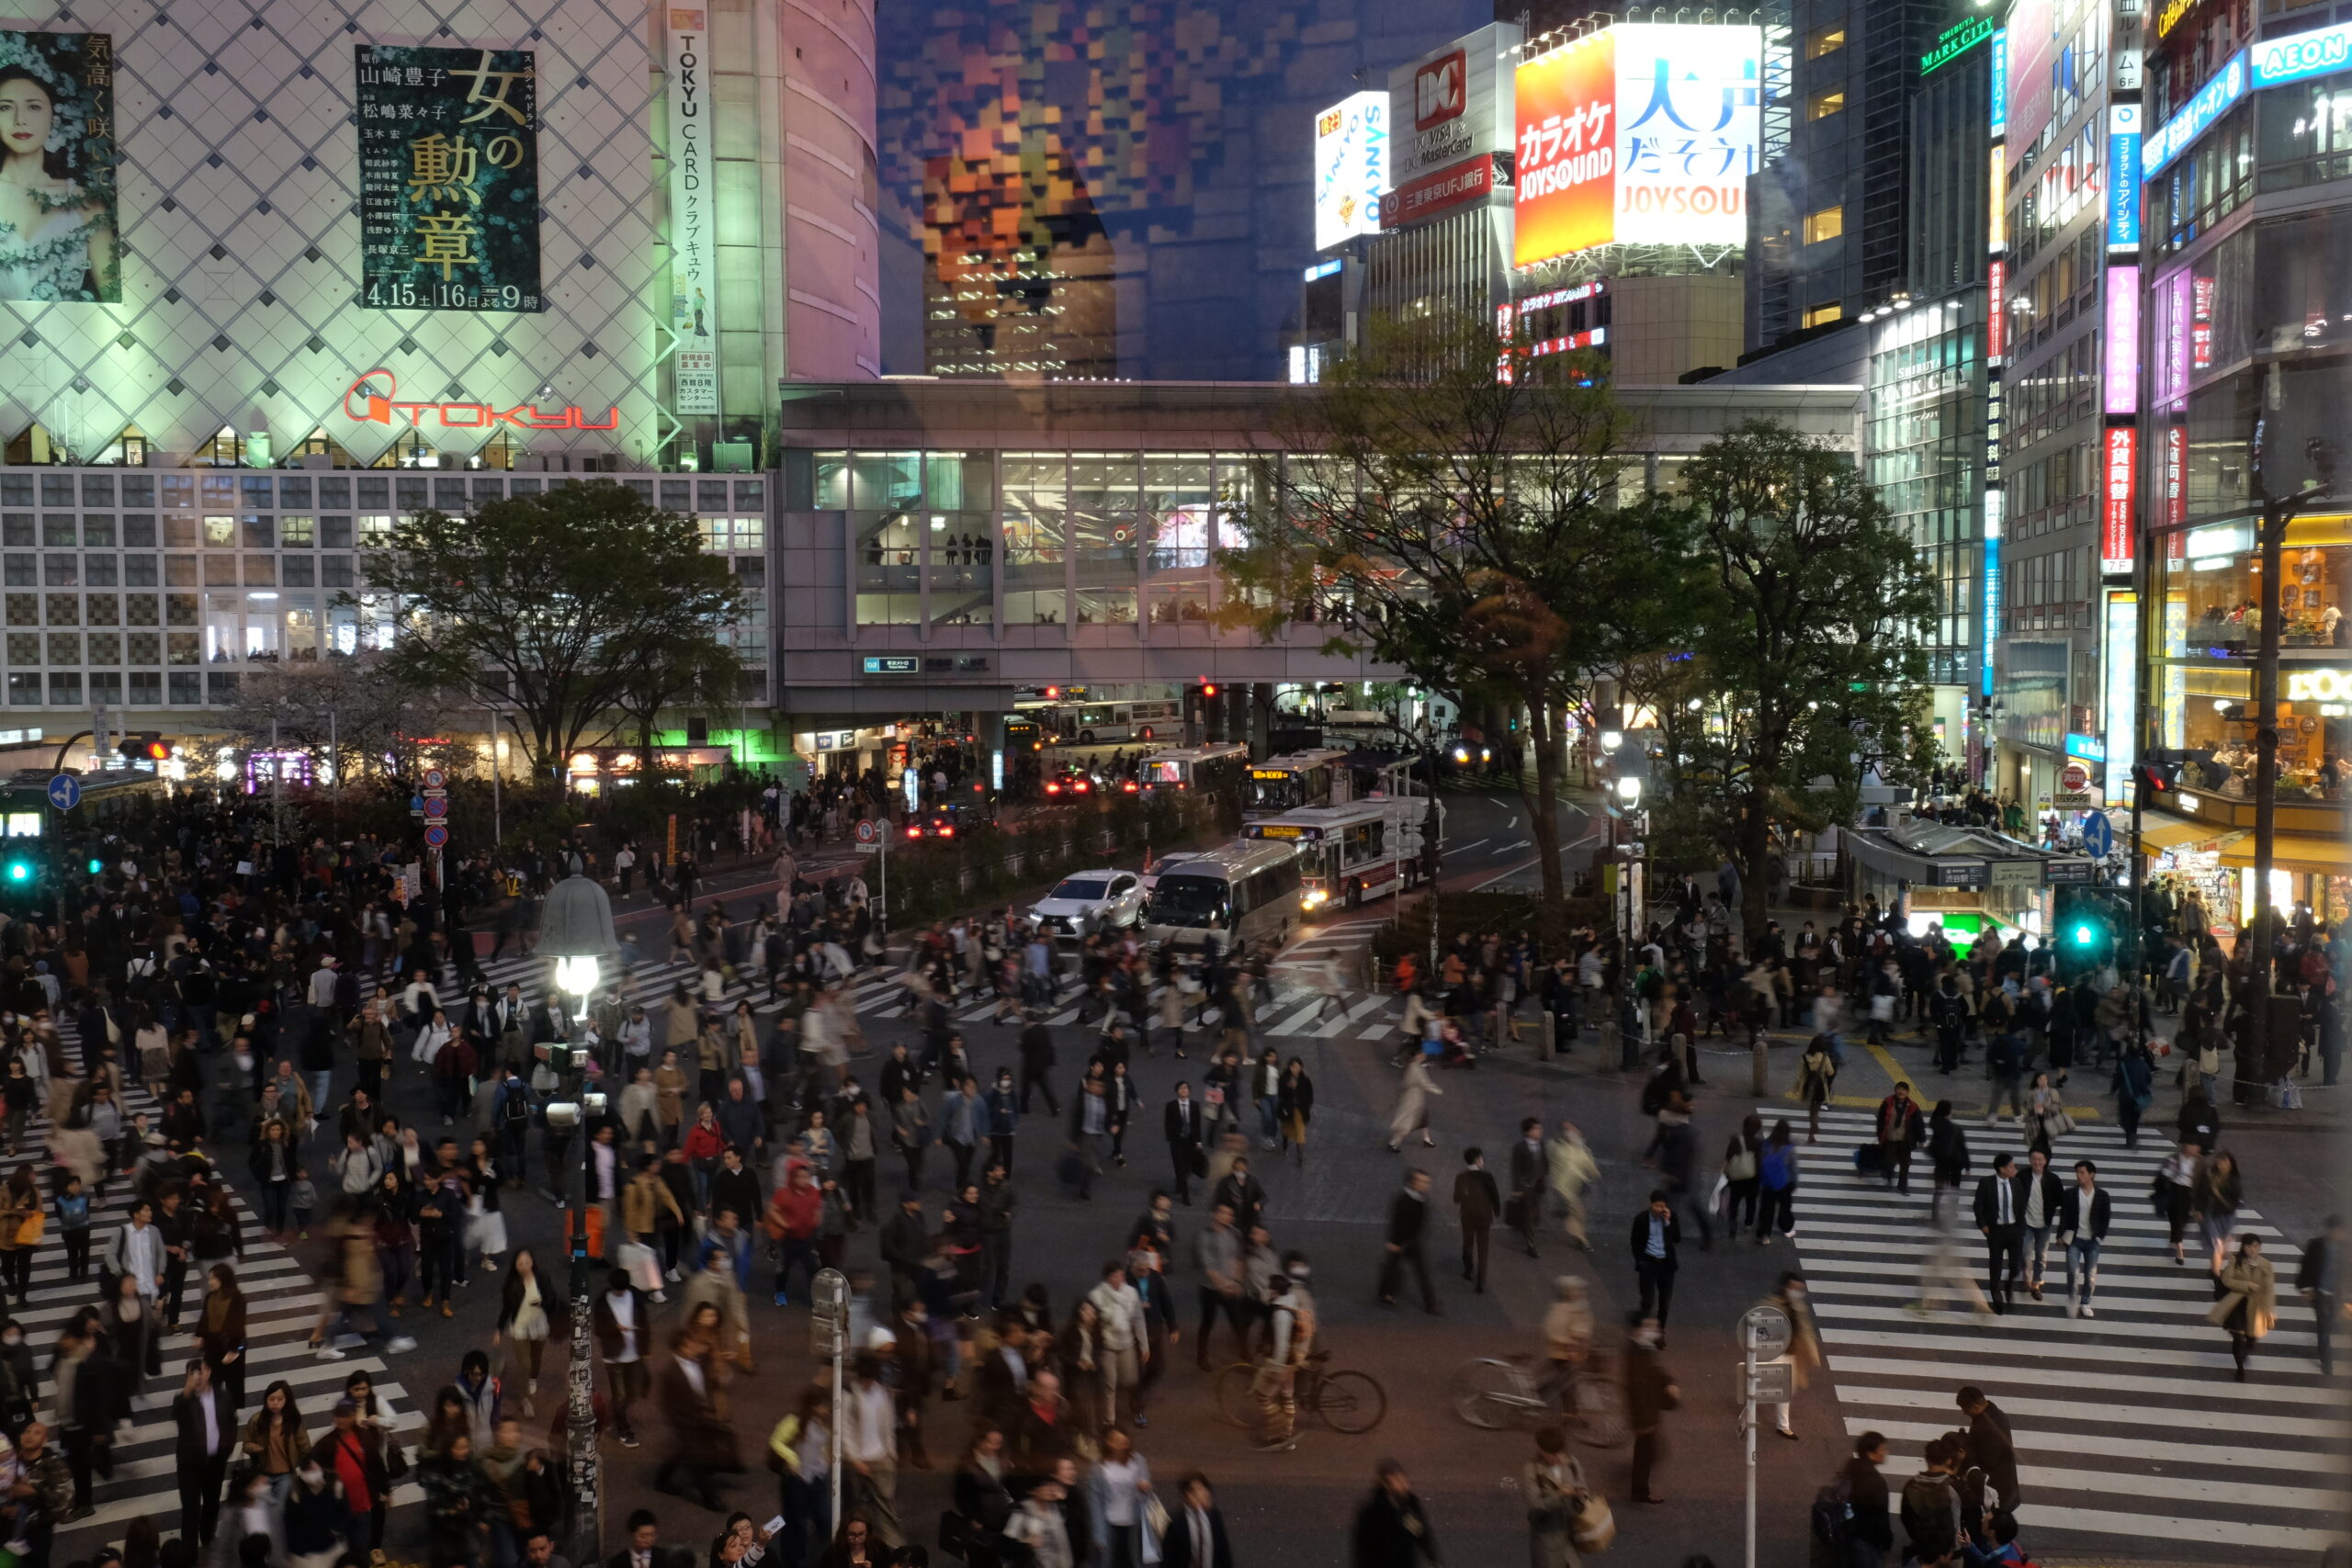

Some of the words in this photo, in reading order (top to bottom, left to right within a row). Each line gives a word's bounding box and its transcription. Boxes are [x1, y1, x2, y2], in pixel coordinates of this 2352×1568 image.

[1920, 38, 1959, 70] MARK
[1961, 16, 1994, 45] CITY
[1939, 16, 1975, 43] SHIBUYA
[2263, 35, 2346, 76] AEON
[361, 66, 447, 87] 山崎豊子
[523, 55, 535, 130] スペシャルドラマ
[679, 36, 697, 118] TOKYU
[1418, 59, 1459, 123] DC
[2119, 77, 2135, 87] 6F
[362, 103, 447, 120] 松嶋菜々子
[1405, 154, 1420, 173] DC
[1420, 132, 1475, 167] MasterCard
[1413, 134, 1430, 152] DC
[1430, 124, 1453, 146] VISA
[1519, 100, 1611, 170] カラオケ
[683, 124, 699, 190] CARD
[1365, 106, 1389, 221] SANKYO
[1519, 146, 1613, 203] JOYSOUND
[1406, 168, 1484, 210] 三菱東京UFJ銀行
[1622, 185, 1747, 215] JOYSOU
[2117, 137, 2131, 240] コンタクトのアイシティ
[368, 244, 411, 255] 長塚京三
[1521, 295, 1553, 313] カラオケ
[391, 400, 618, 430] TOKYU
[2110, 397, 2132, 410] 4F
[2110, 430, 2131, 501] 外貨両替
[2109, 560, 2126, 571] 7F
